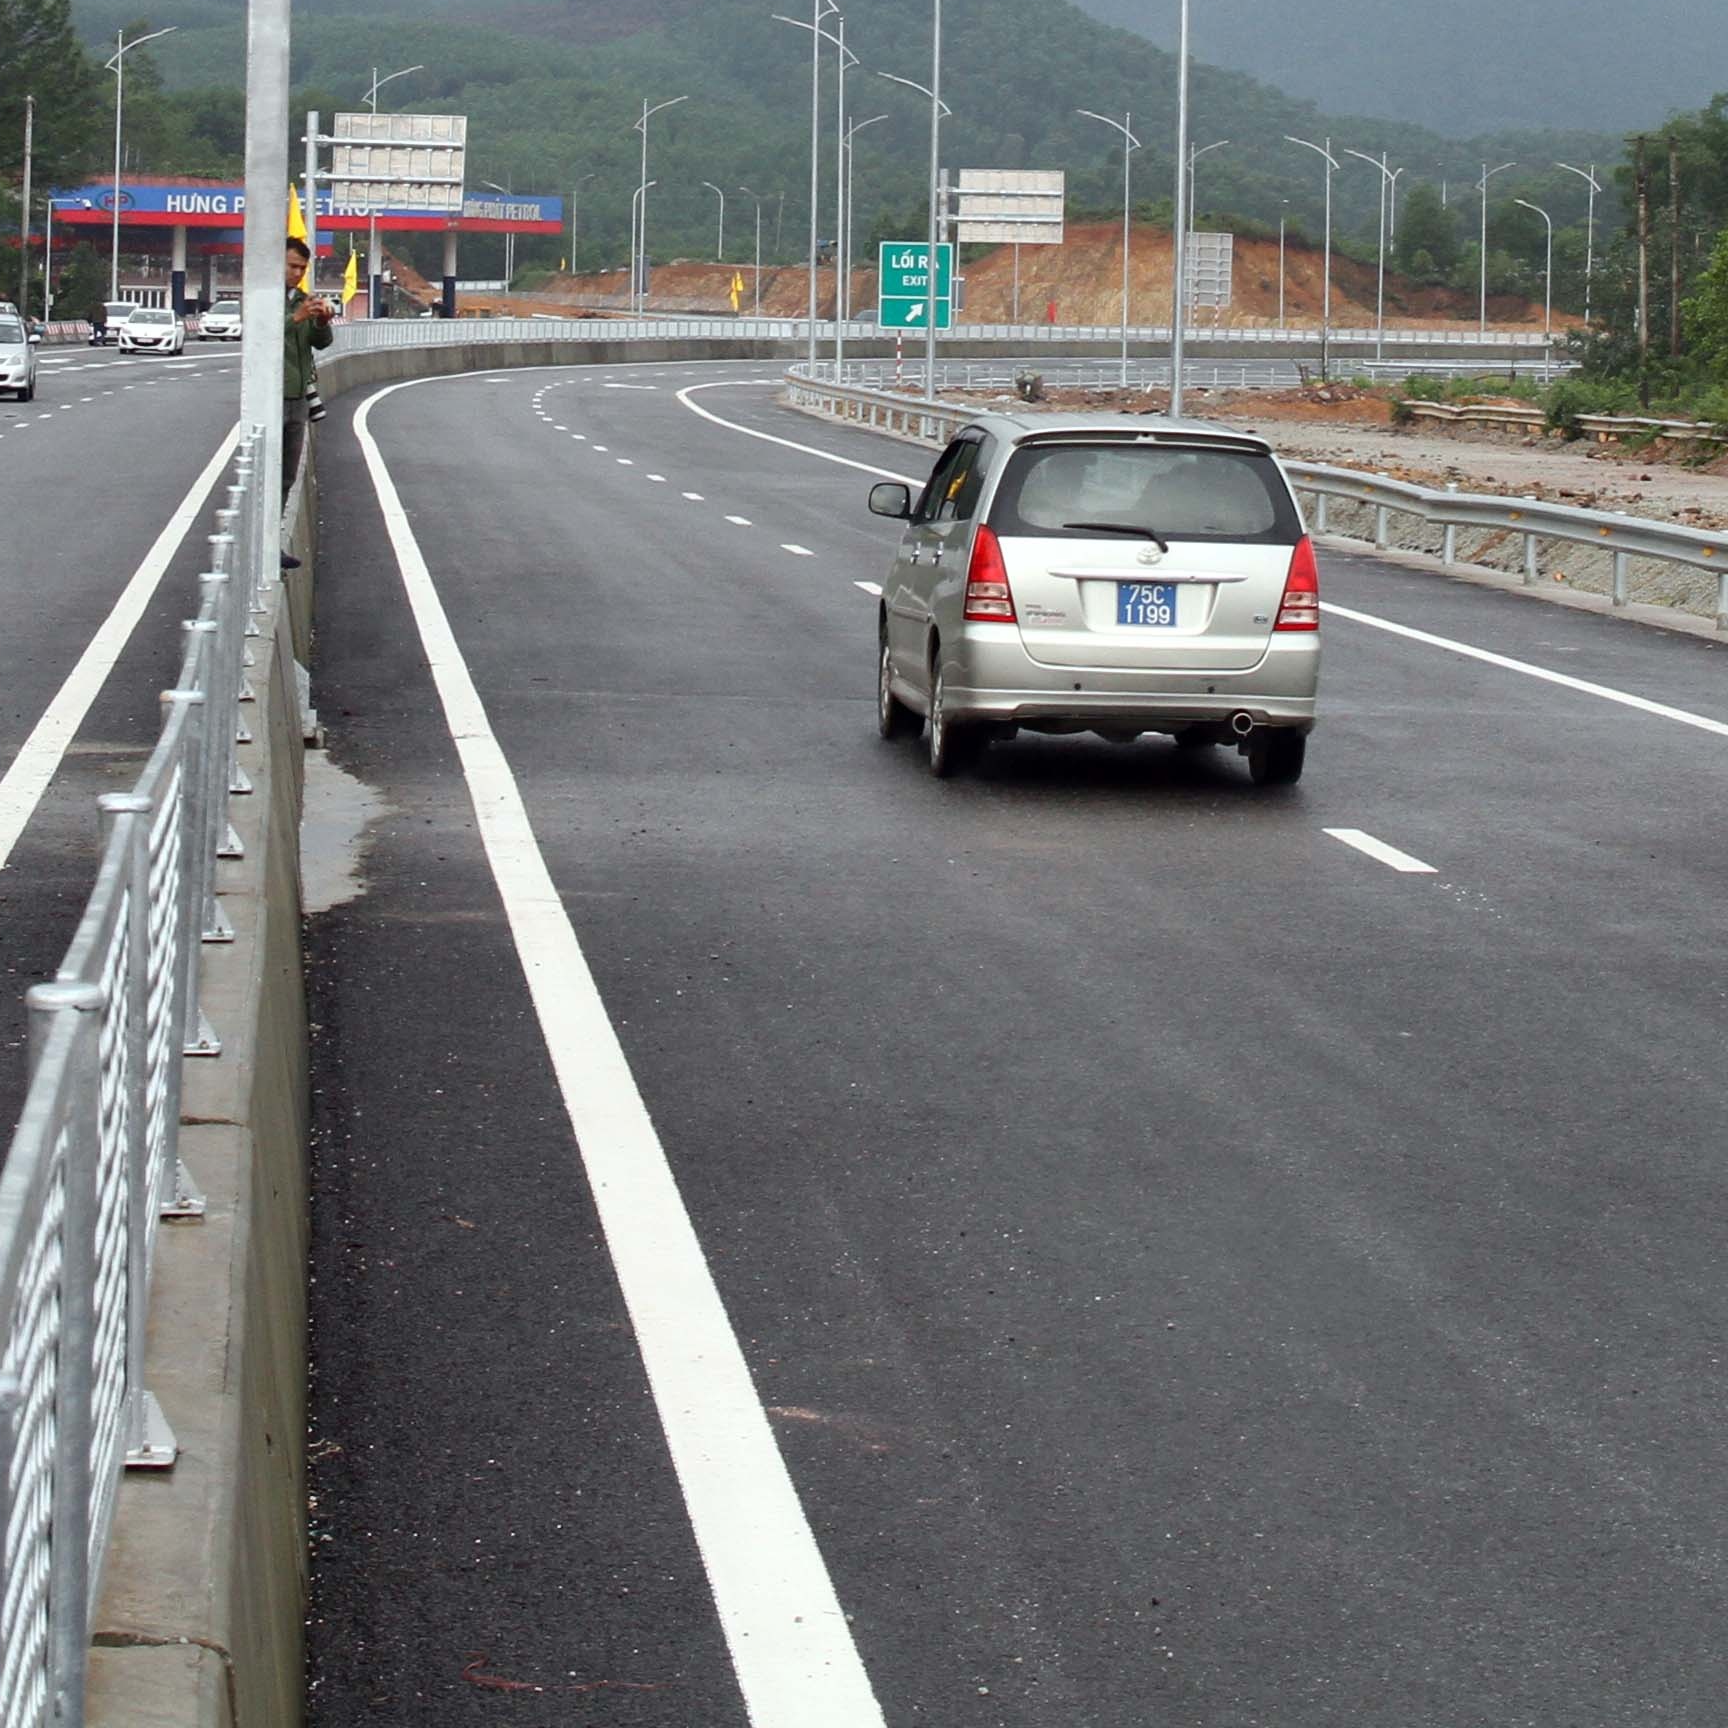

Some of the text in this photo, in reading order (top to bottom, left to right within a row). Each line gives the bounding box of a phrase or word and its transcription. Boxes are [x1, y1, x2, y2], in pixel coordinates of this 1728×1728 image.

[167, 192, 227, 214] HƯNG
[892, 249, 914, 269] LỐI
[902, 275, 928, 287] EXIT
[1128, 584, 1165, 605] 75C
[1125, 604, 1171, 624] 1199
